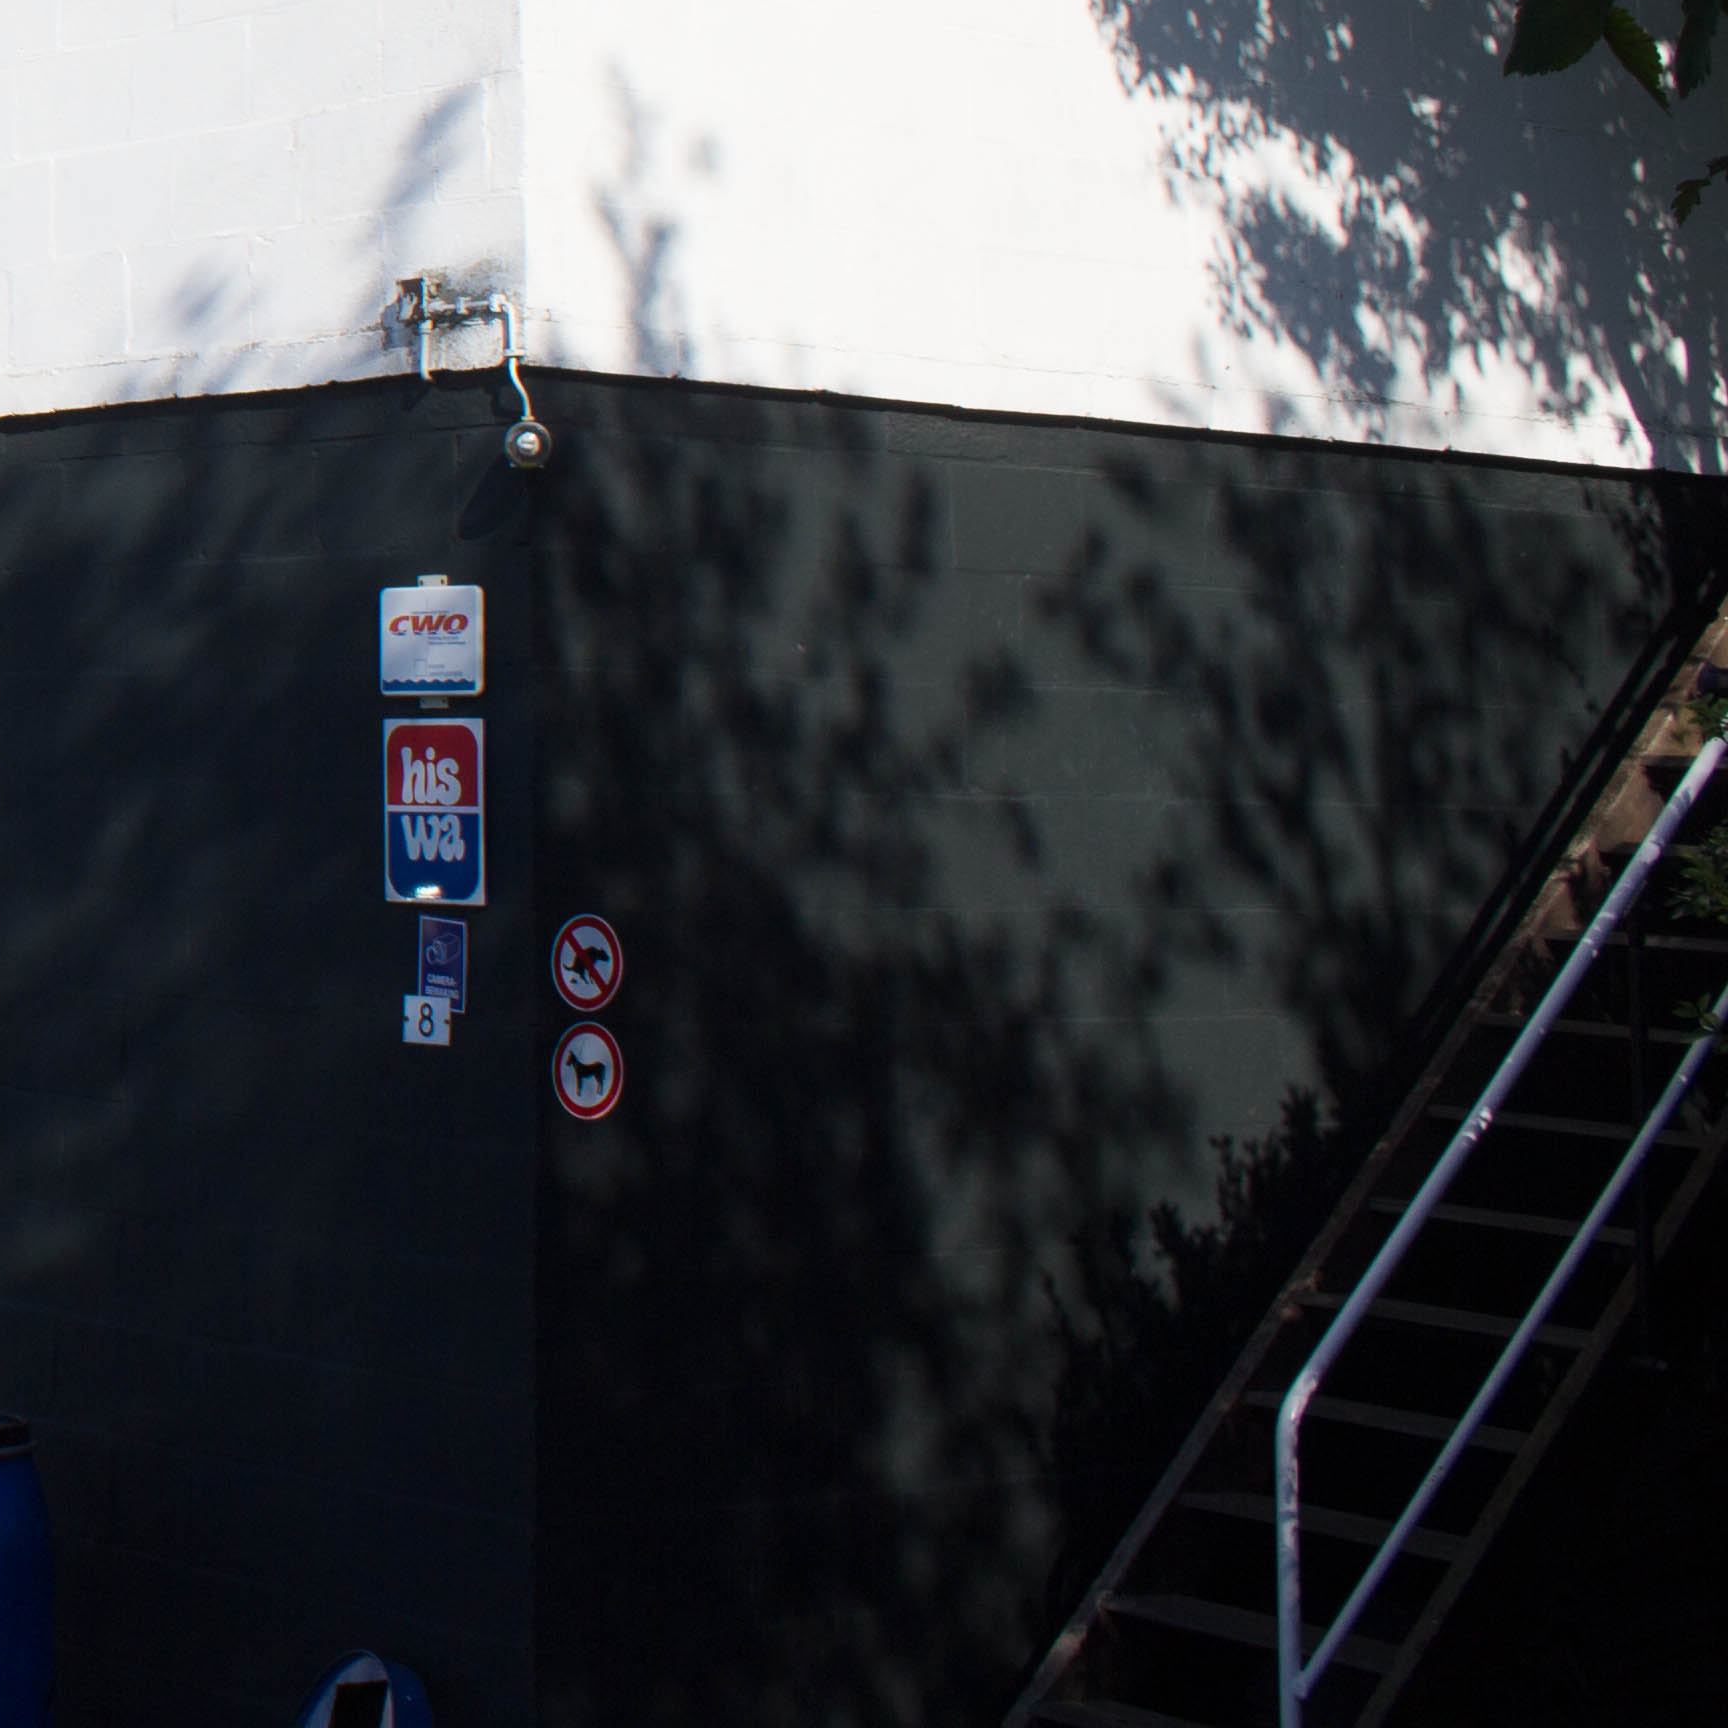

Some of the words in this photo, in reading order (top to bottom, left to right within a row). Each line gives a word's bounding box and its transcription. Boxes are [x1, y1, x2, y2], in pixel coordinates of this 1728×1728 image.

[388, 613, 468, 636] CWO
[400, 746, 462, 806] his
[400, 813, 466, 862] wa
[418, 1002, 434, 1037] 8
